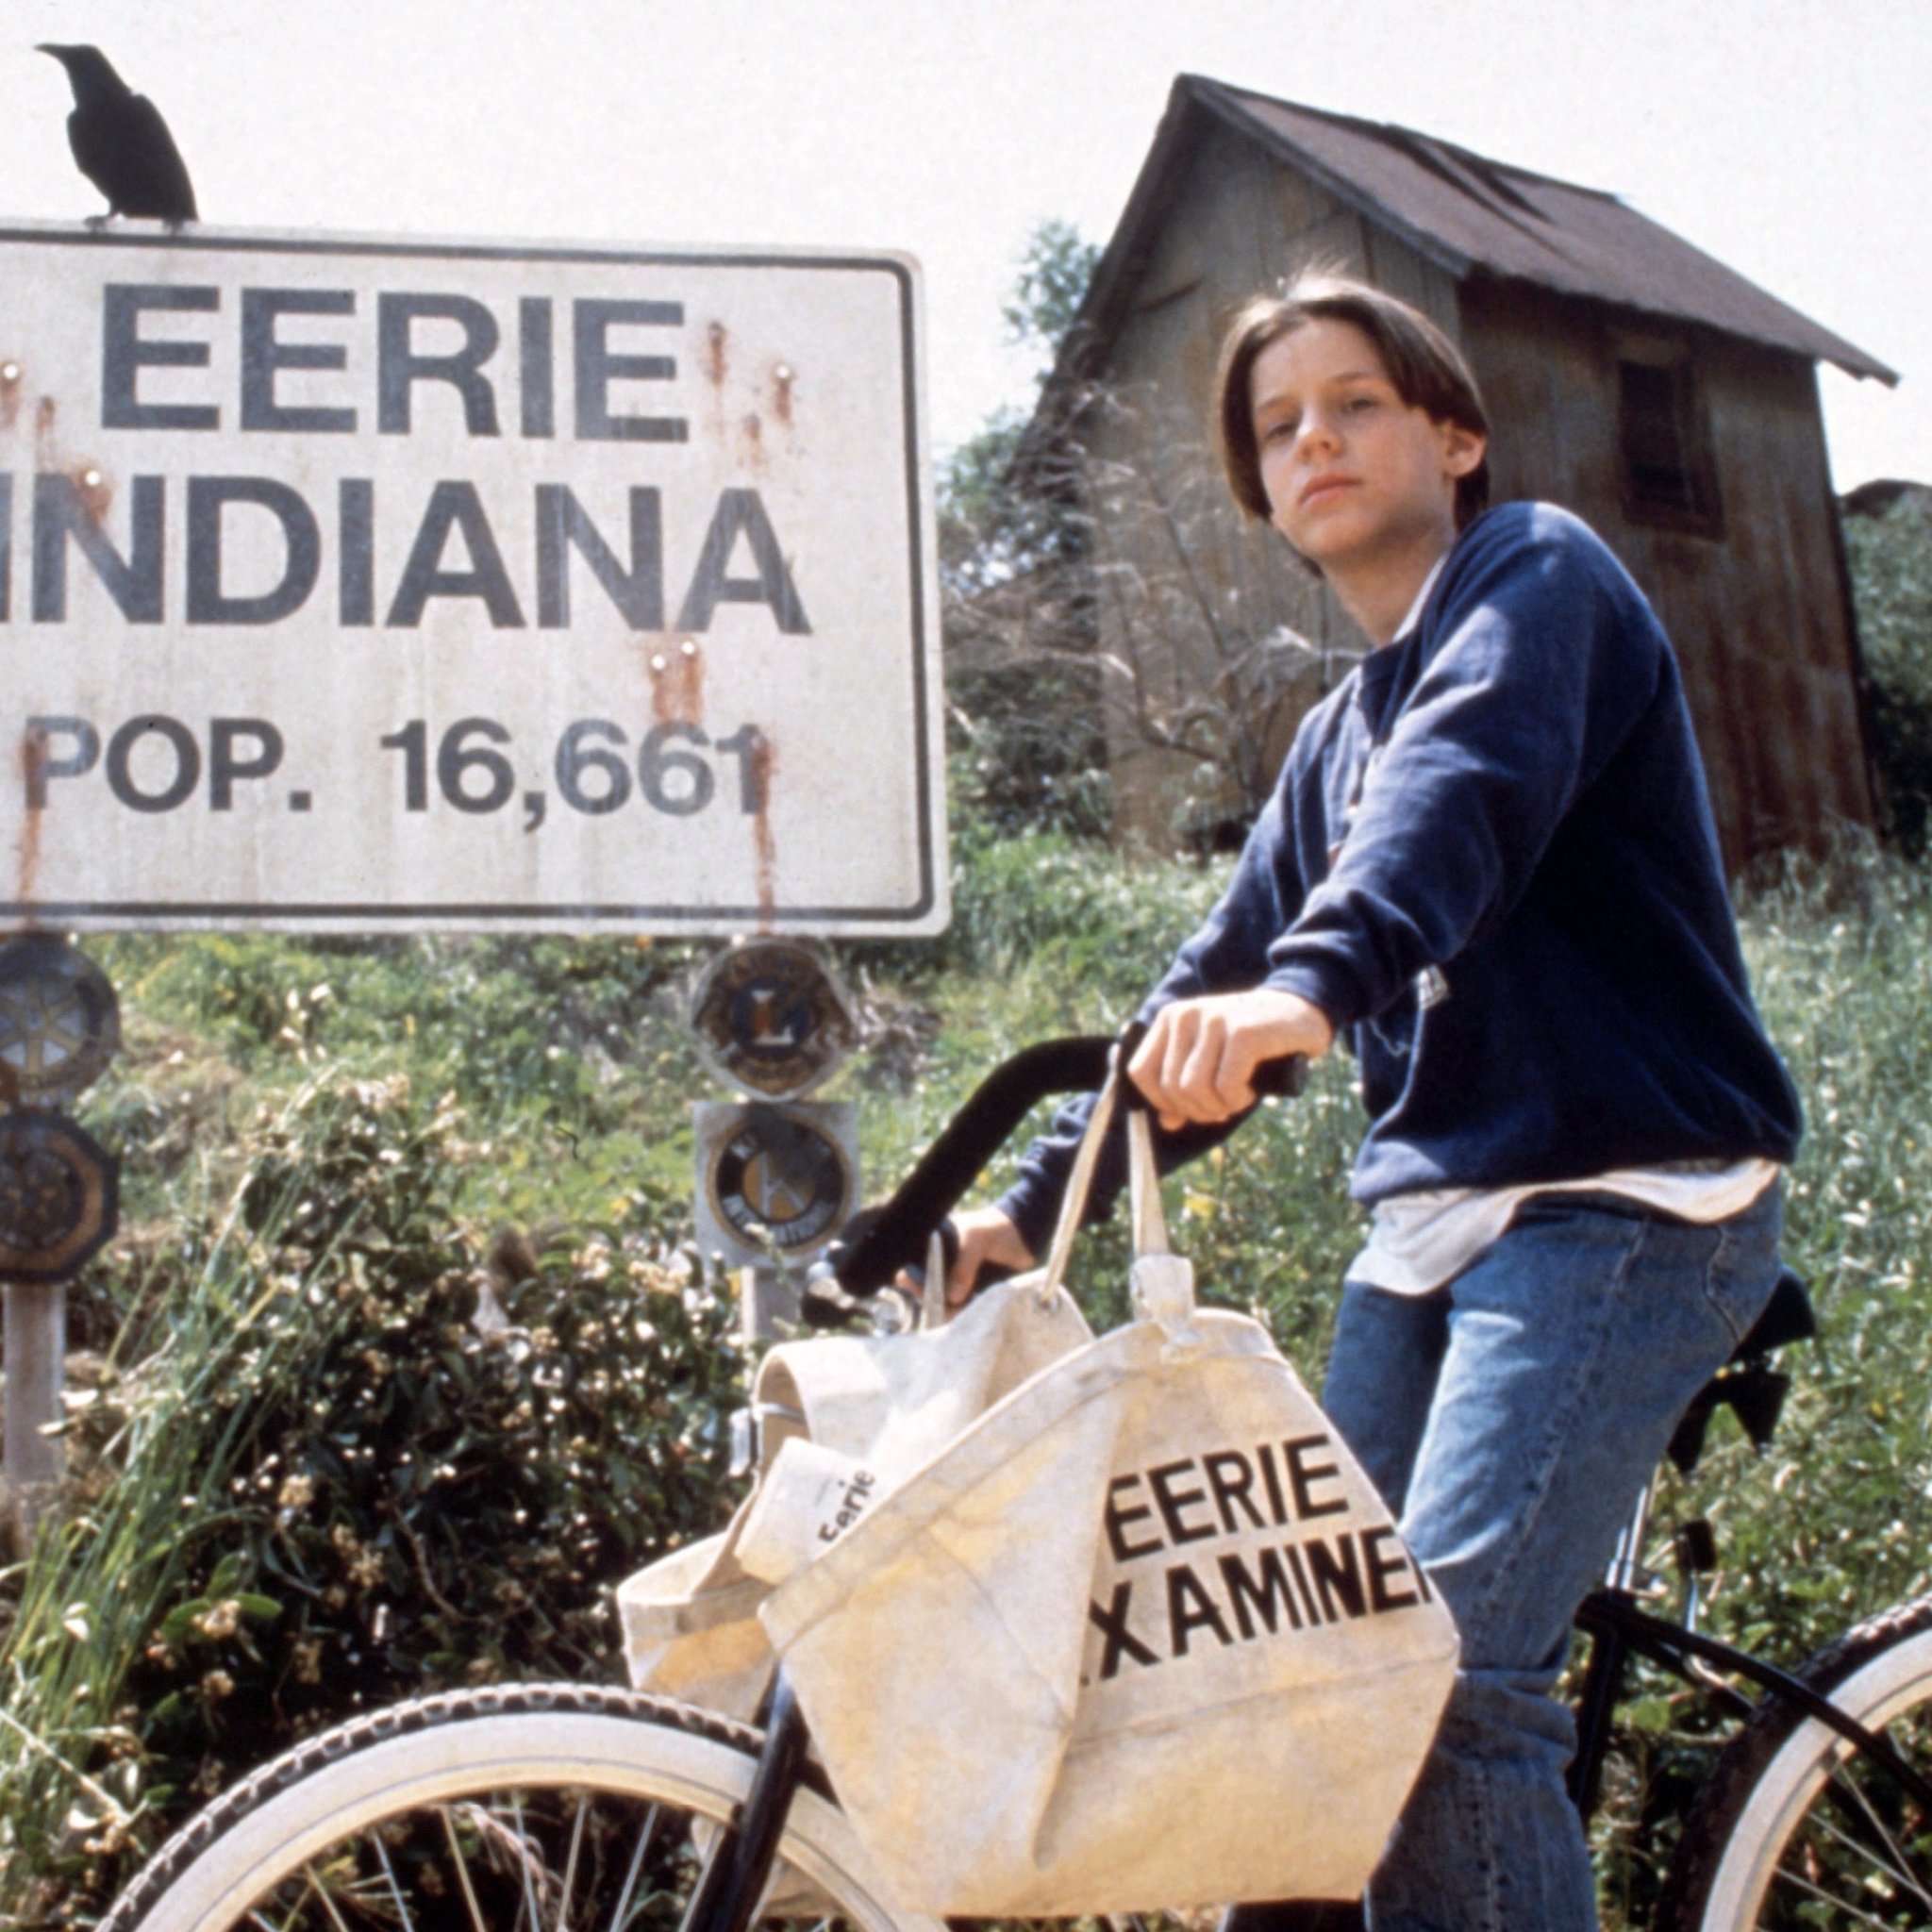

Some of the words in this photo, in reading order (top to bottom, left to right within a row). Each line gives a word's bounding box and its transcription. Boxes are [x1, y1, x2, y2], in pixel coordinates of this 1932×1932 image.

[101, 283, 689, 442] EERIE
[24, 714, 312, 813] POP.
[379, 716, 770, 834] 16,661
[1104, 1432, 1350, 1563] EERIE
[1079, 1524, 1433, 1688] XAMINE
